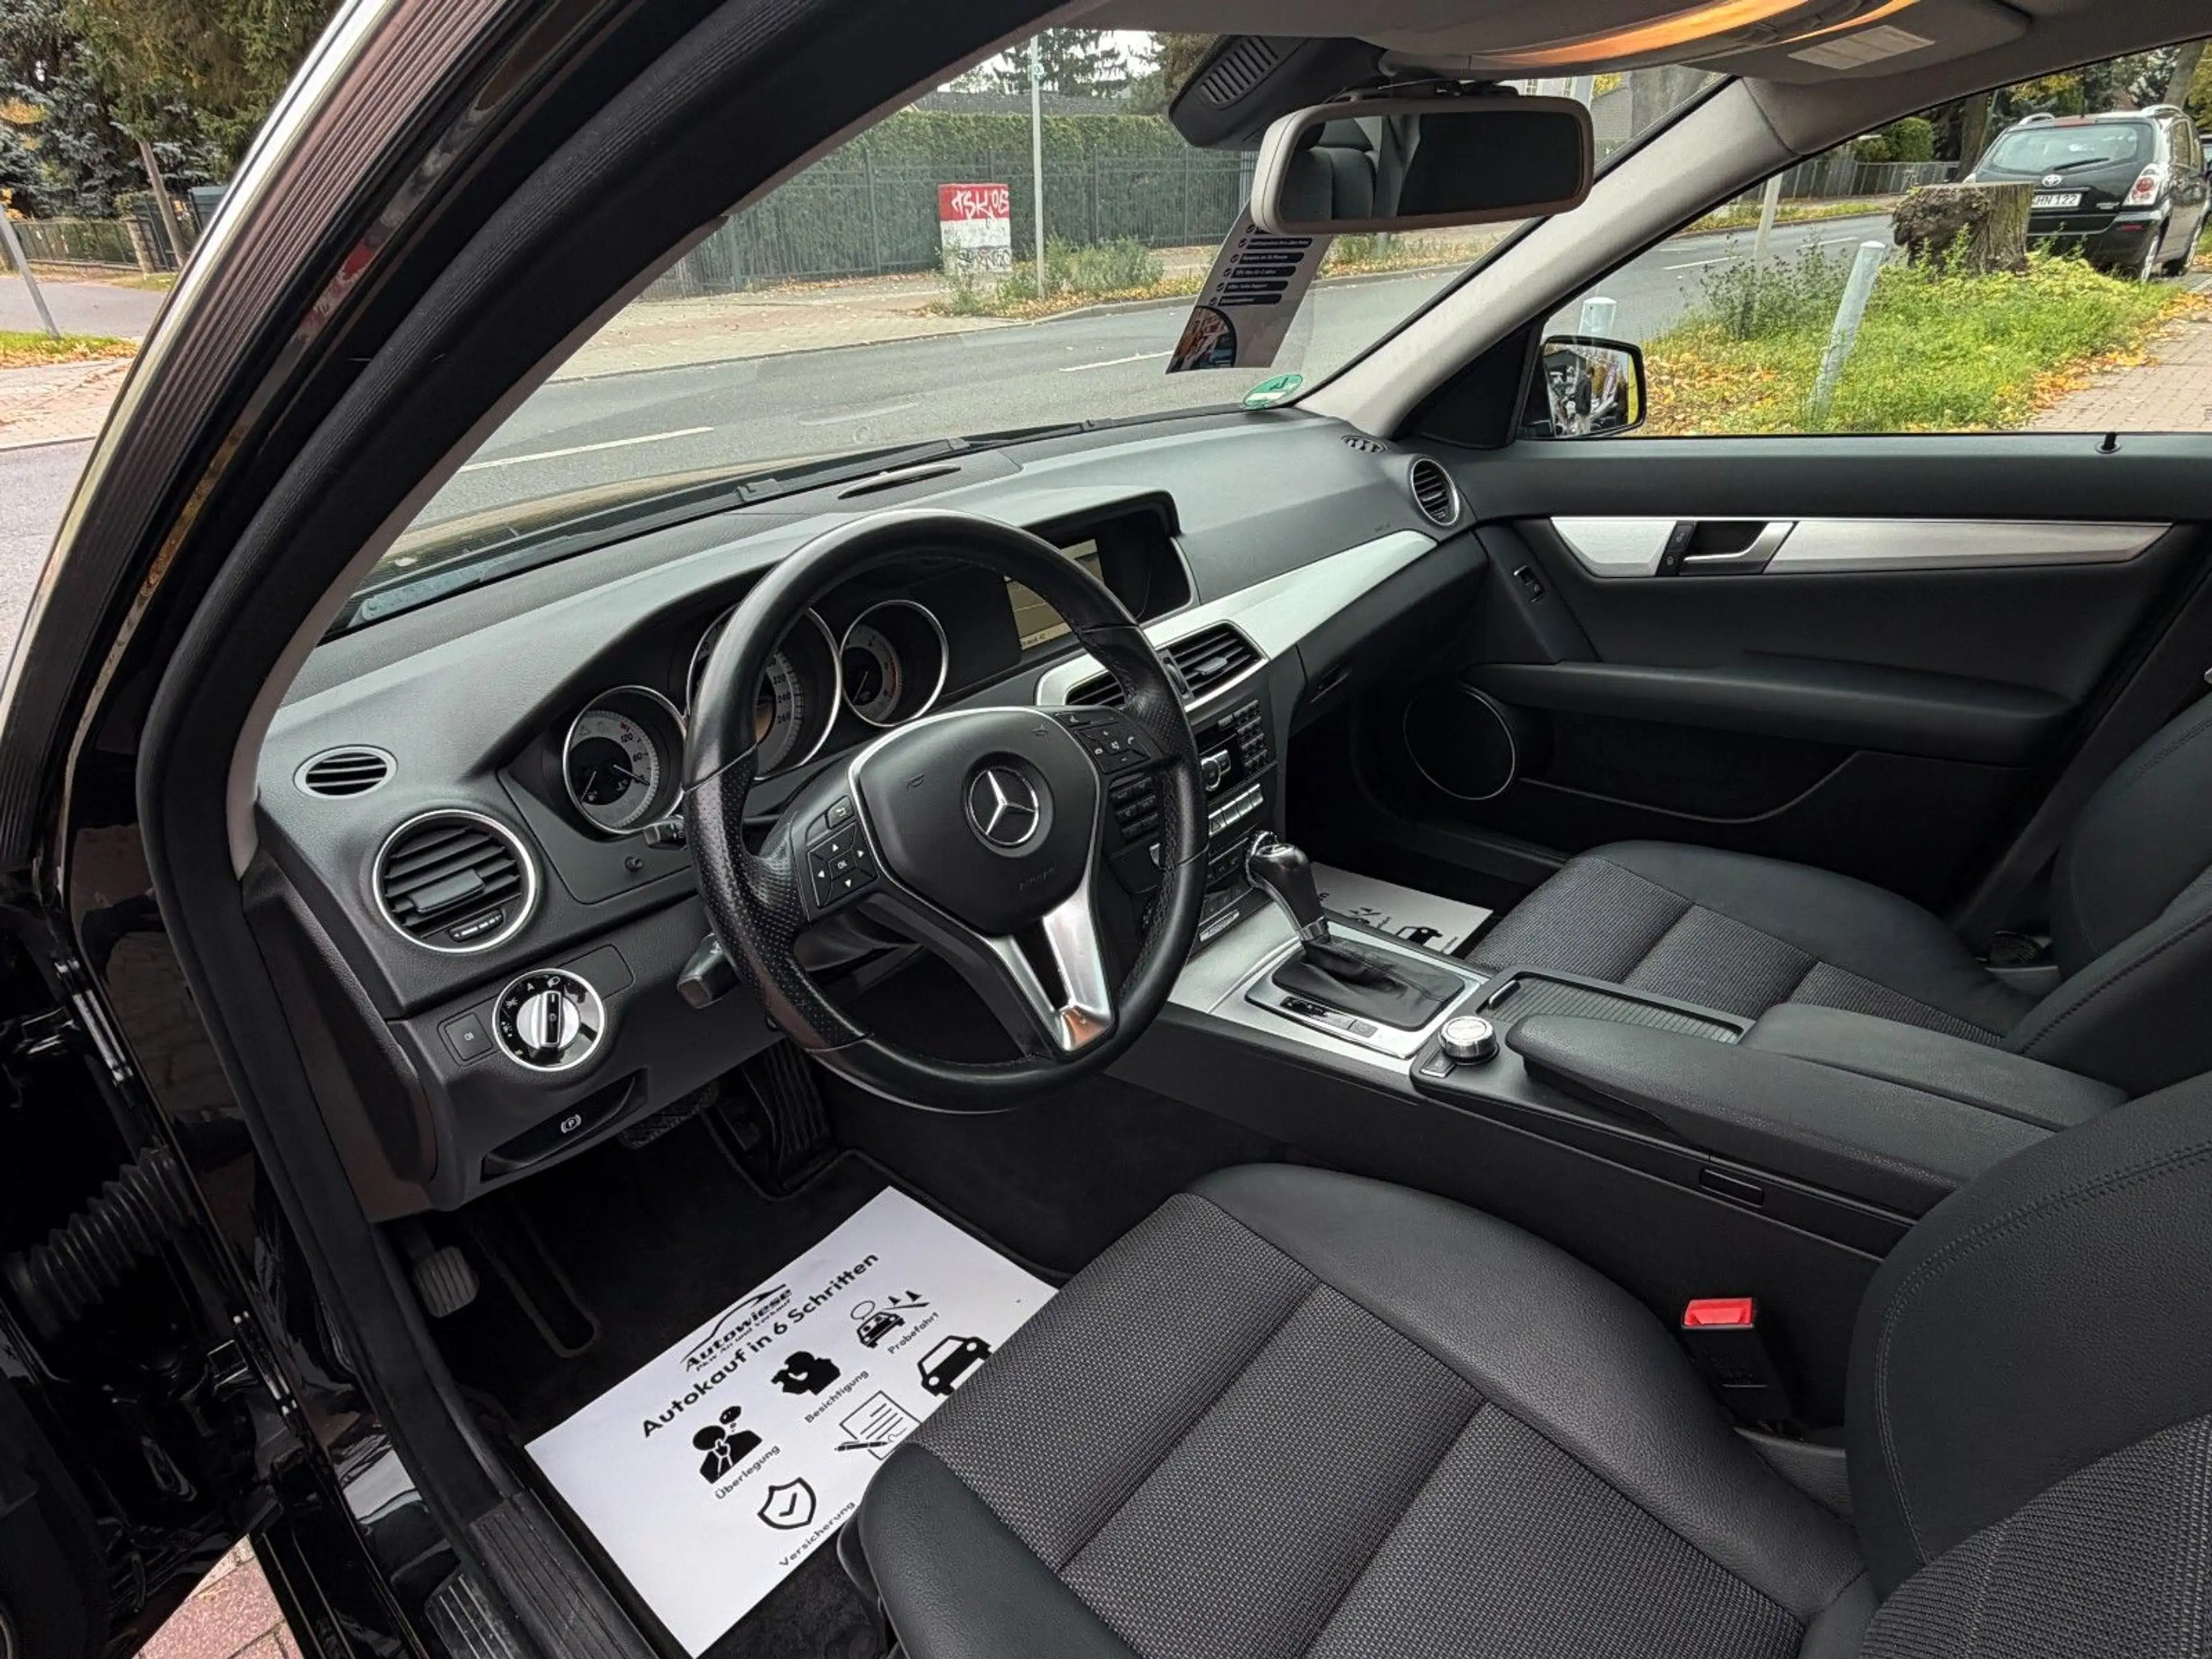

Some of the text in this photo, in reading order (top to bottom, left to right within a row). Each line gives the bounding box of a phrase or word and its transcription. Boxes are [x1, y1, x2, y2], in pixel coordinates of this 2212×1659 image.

[838, 859, 848, 869] OK
[643, 1253, 879, 1438] Autokauf in 6 Schritten
[686, 1289, 793, 1372] Autowiese
[888, 1311, 940, 1354] Probefahrt
[805, 1370, 870, 1423] Besichtigung
[714, 1445, 781, 1499] Überlegung
[778, 1501, 856, 1567] Versicherung
